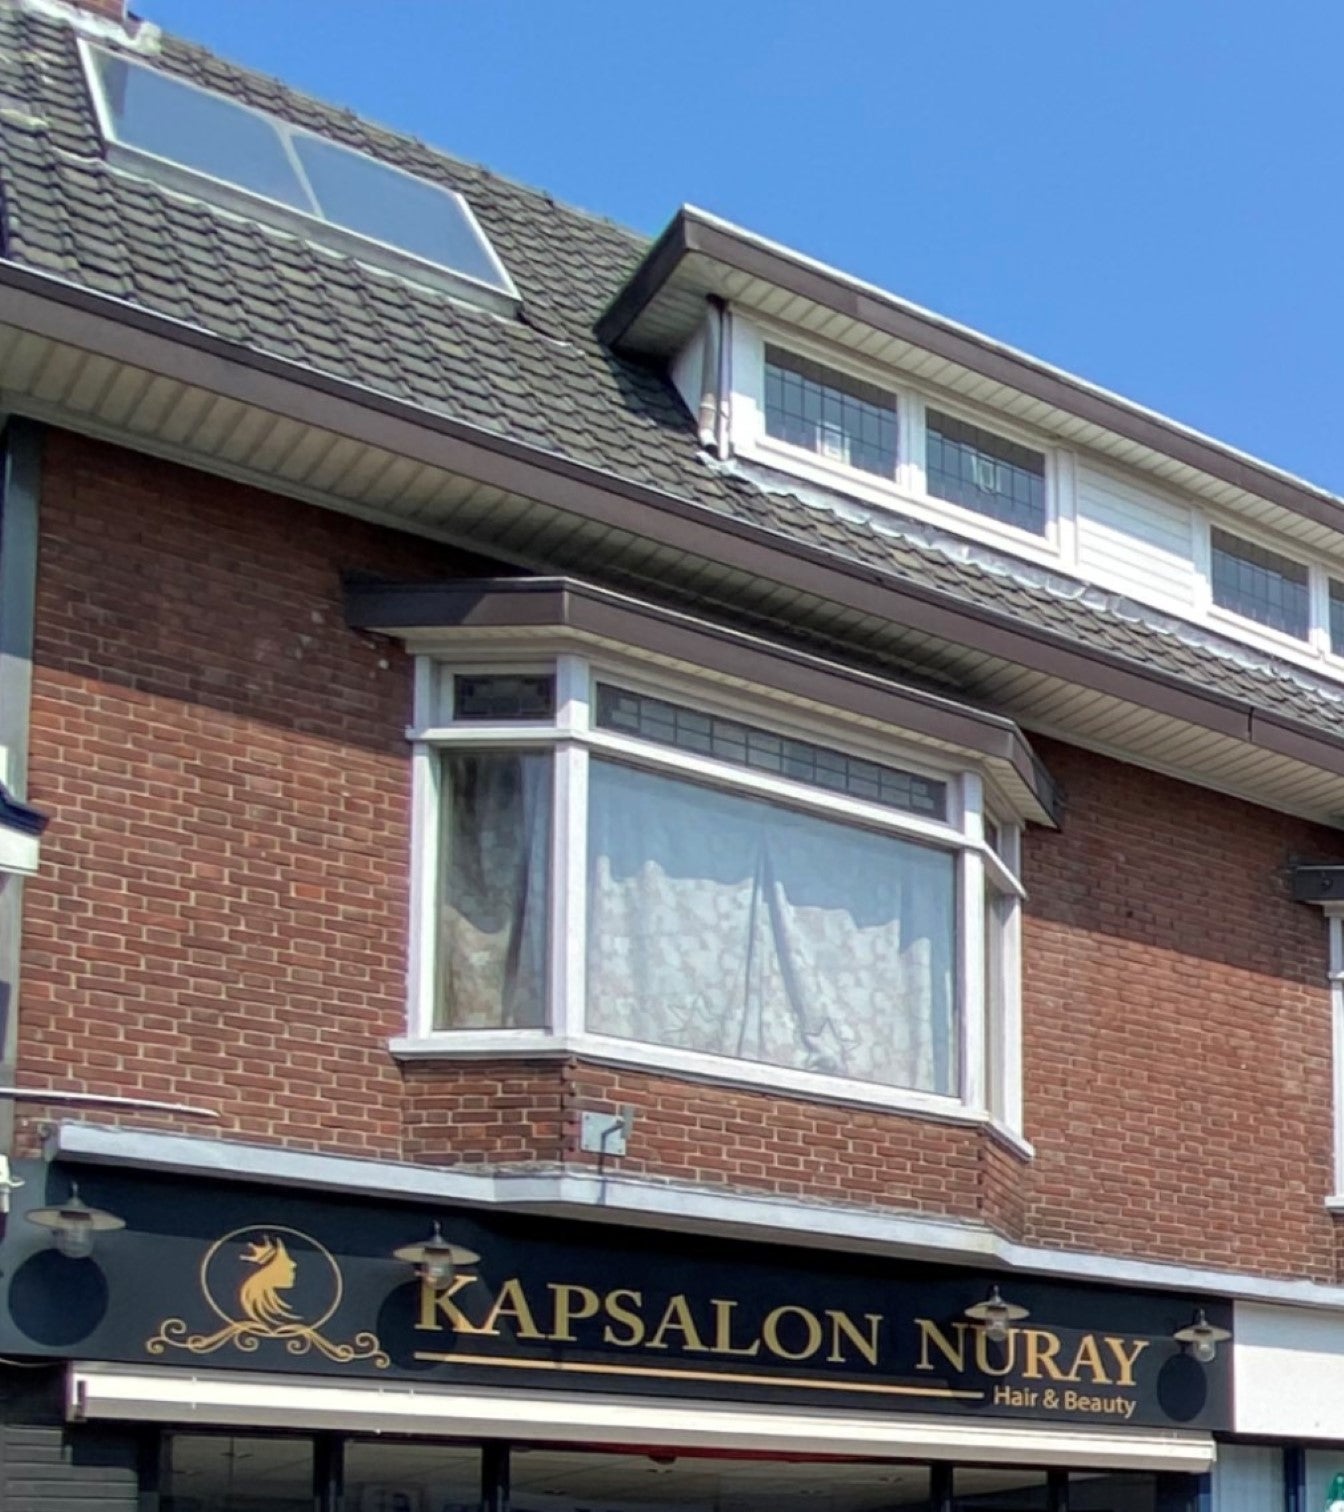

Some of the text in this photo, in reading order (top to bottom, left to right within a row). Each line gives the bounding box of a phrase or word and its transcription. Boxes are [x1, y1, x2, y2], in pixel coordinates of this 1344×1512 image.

[414, 1271, 1150, 1386] KAPSALON NURAY
[994, 1385, 1137, 1419] Hair & Beauty
